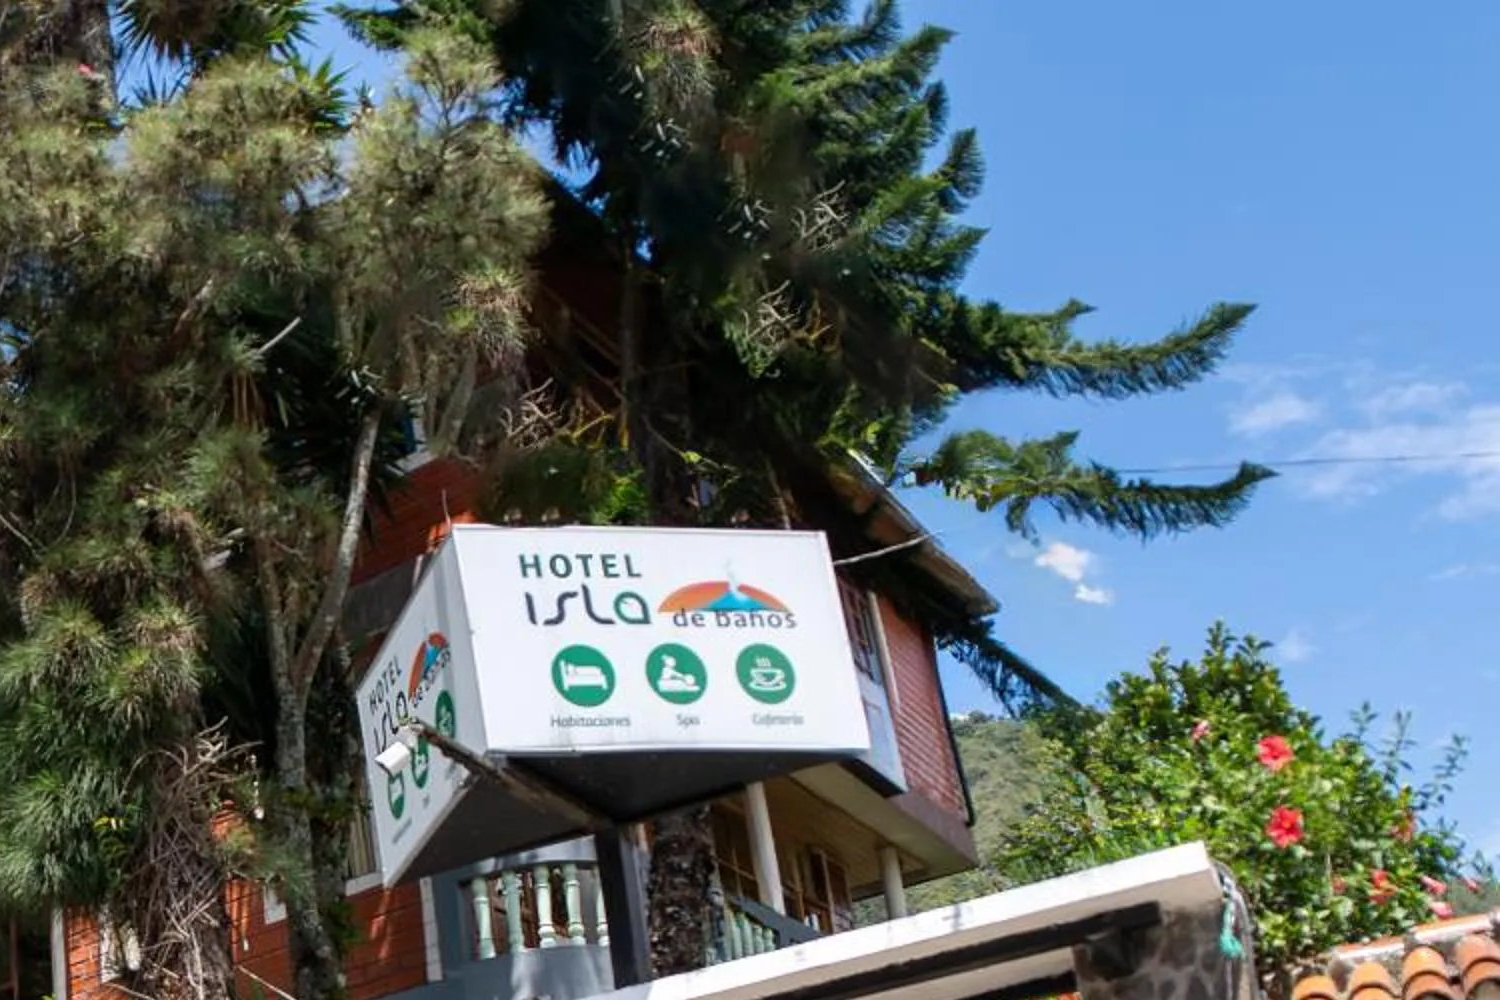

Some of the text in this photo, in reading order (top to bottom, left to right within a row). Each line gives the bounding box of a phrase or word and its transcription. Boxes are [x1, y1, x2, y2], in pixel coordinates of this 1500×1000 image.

[518, 553, 643, 579] HOTEL
[672, 606, 706, 628] de
[369, 655, 402, 717] HOTEL
